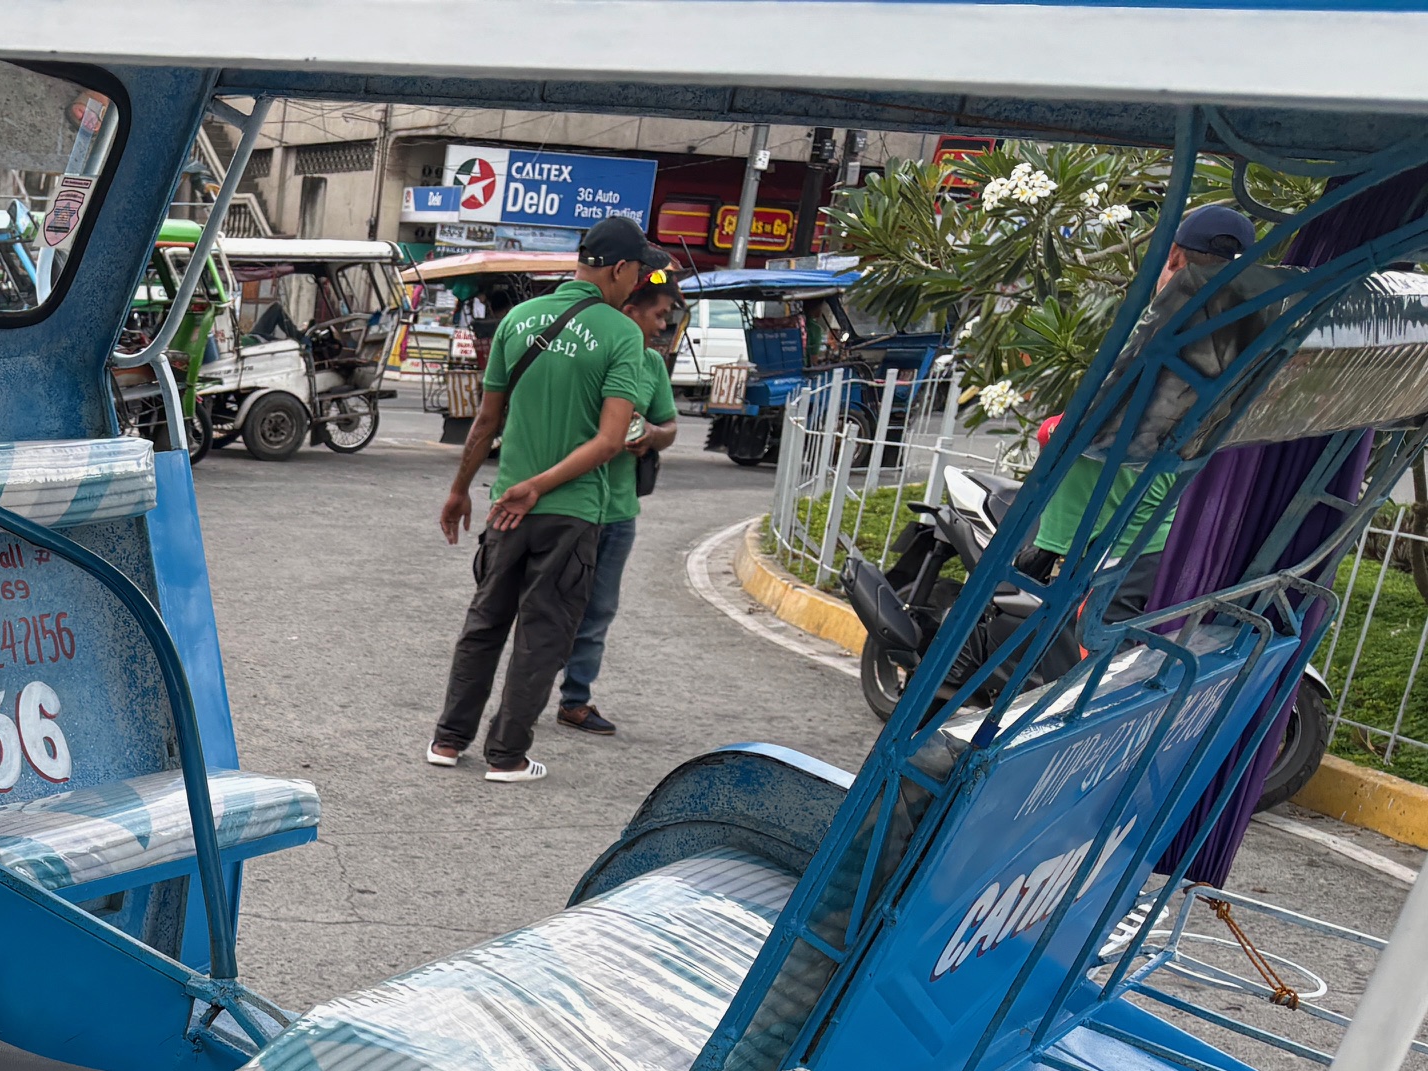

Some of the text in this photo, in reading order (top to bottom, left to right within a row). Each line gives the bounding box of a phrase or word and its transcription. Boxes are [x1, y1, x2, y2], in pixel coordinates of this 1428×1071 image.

[511, 161, 573, 183] CALTEX
[506, 182, 560, 216] Delo
[577, 187, 620, 203] 3G Auto
[574, 203, 644, 224] Parts Trading
[515, 314, 598, 351] DC INRANS
